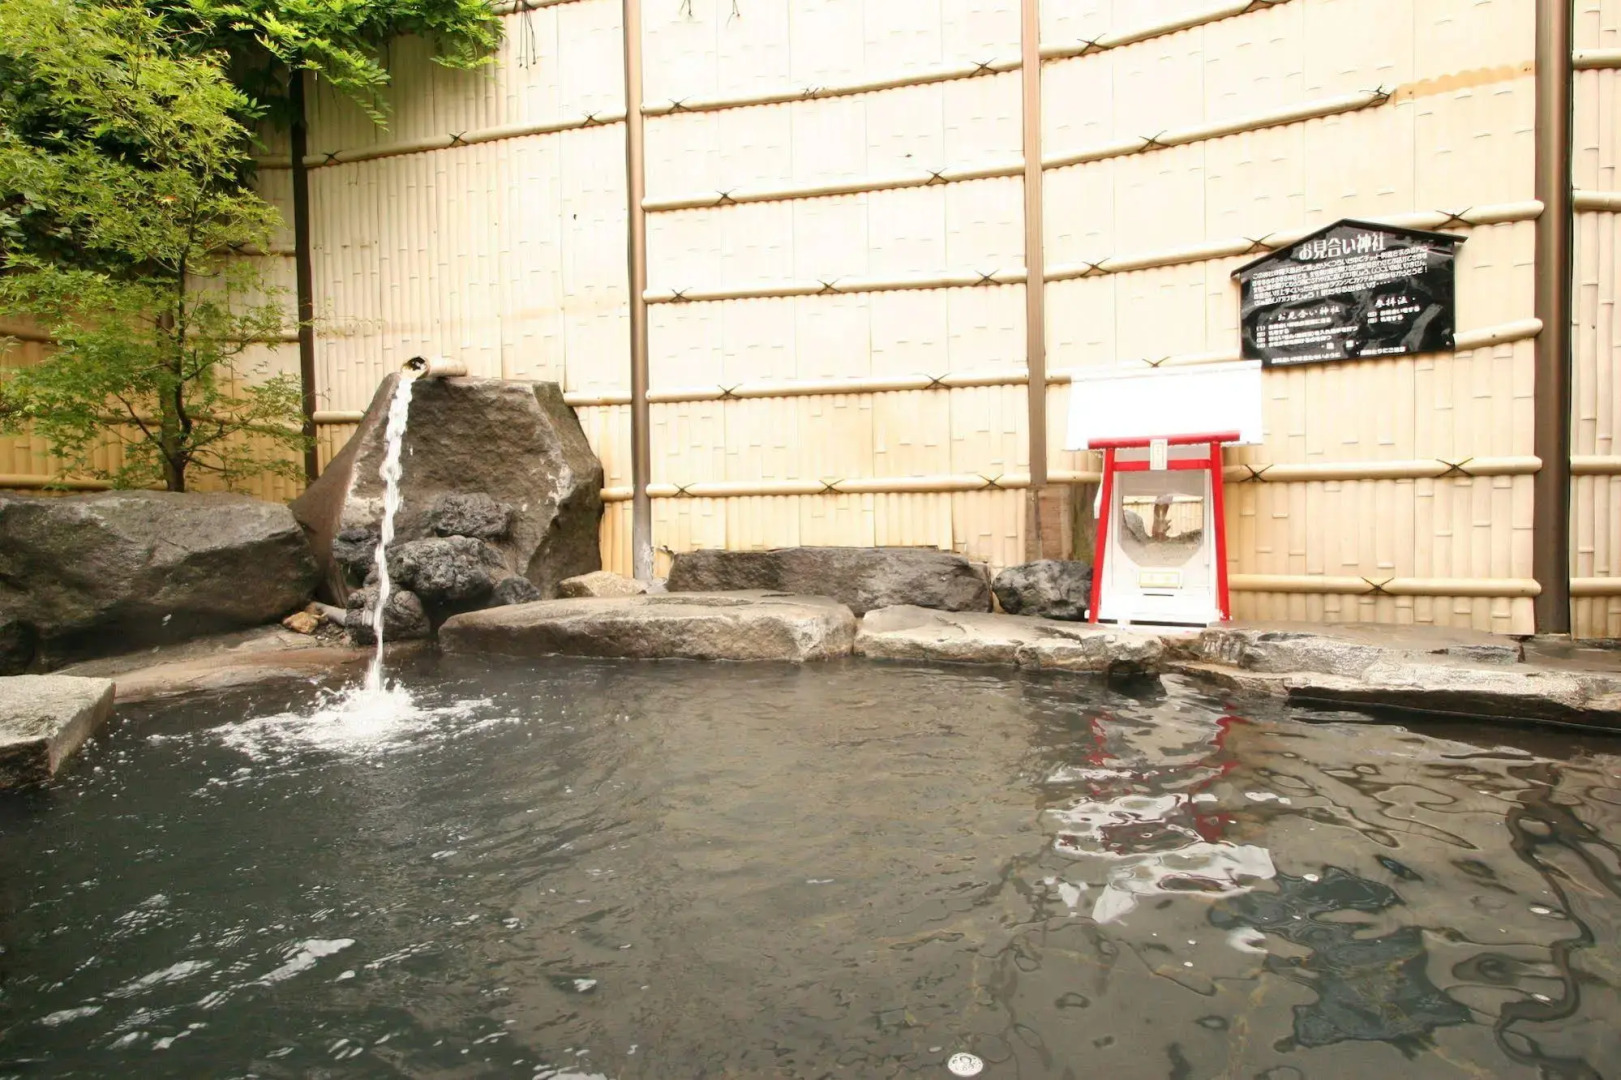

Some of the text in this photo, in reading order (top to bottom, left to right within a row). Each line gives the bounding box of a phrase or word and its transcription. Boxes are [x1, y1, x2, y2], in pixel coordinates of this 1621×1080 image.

[1299, 232, 1386, 260] お見合い神社
[1278, 305, 1341, 321] お見合い神社
